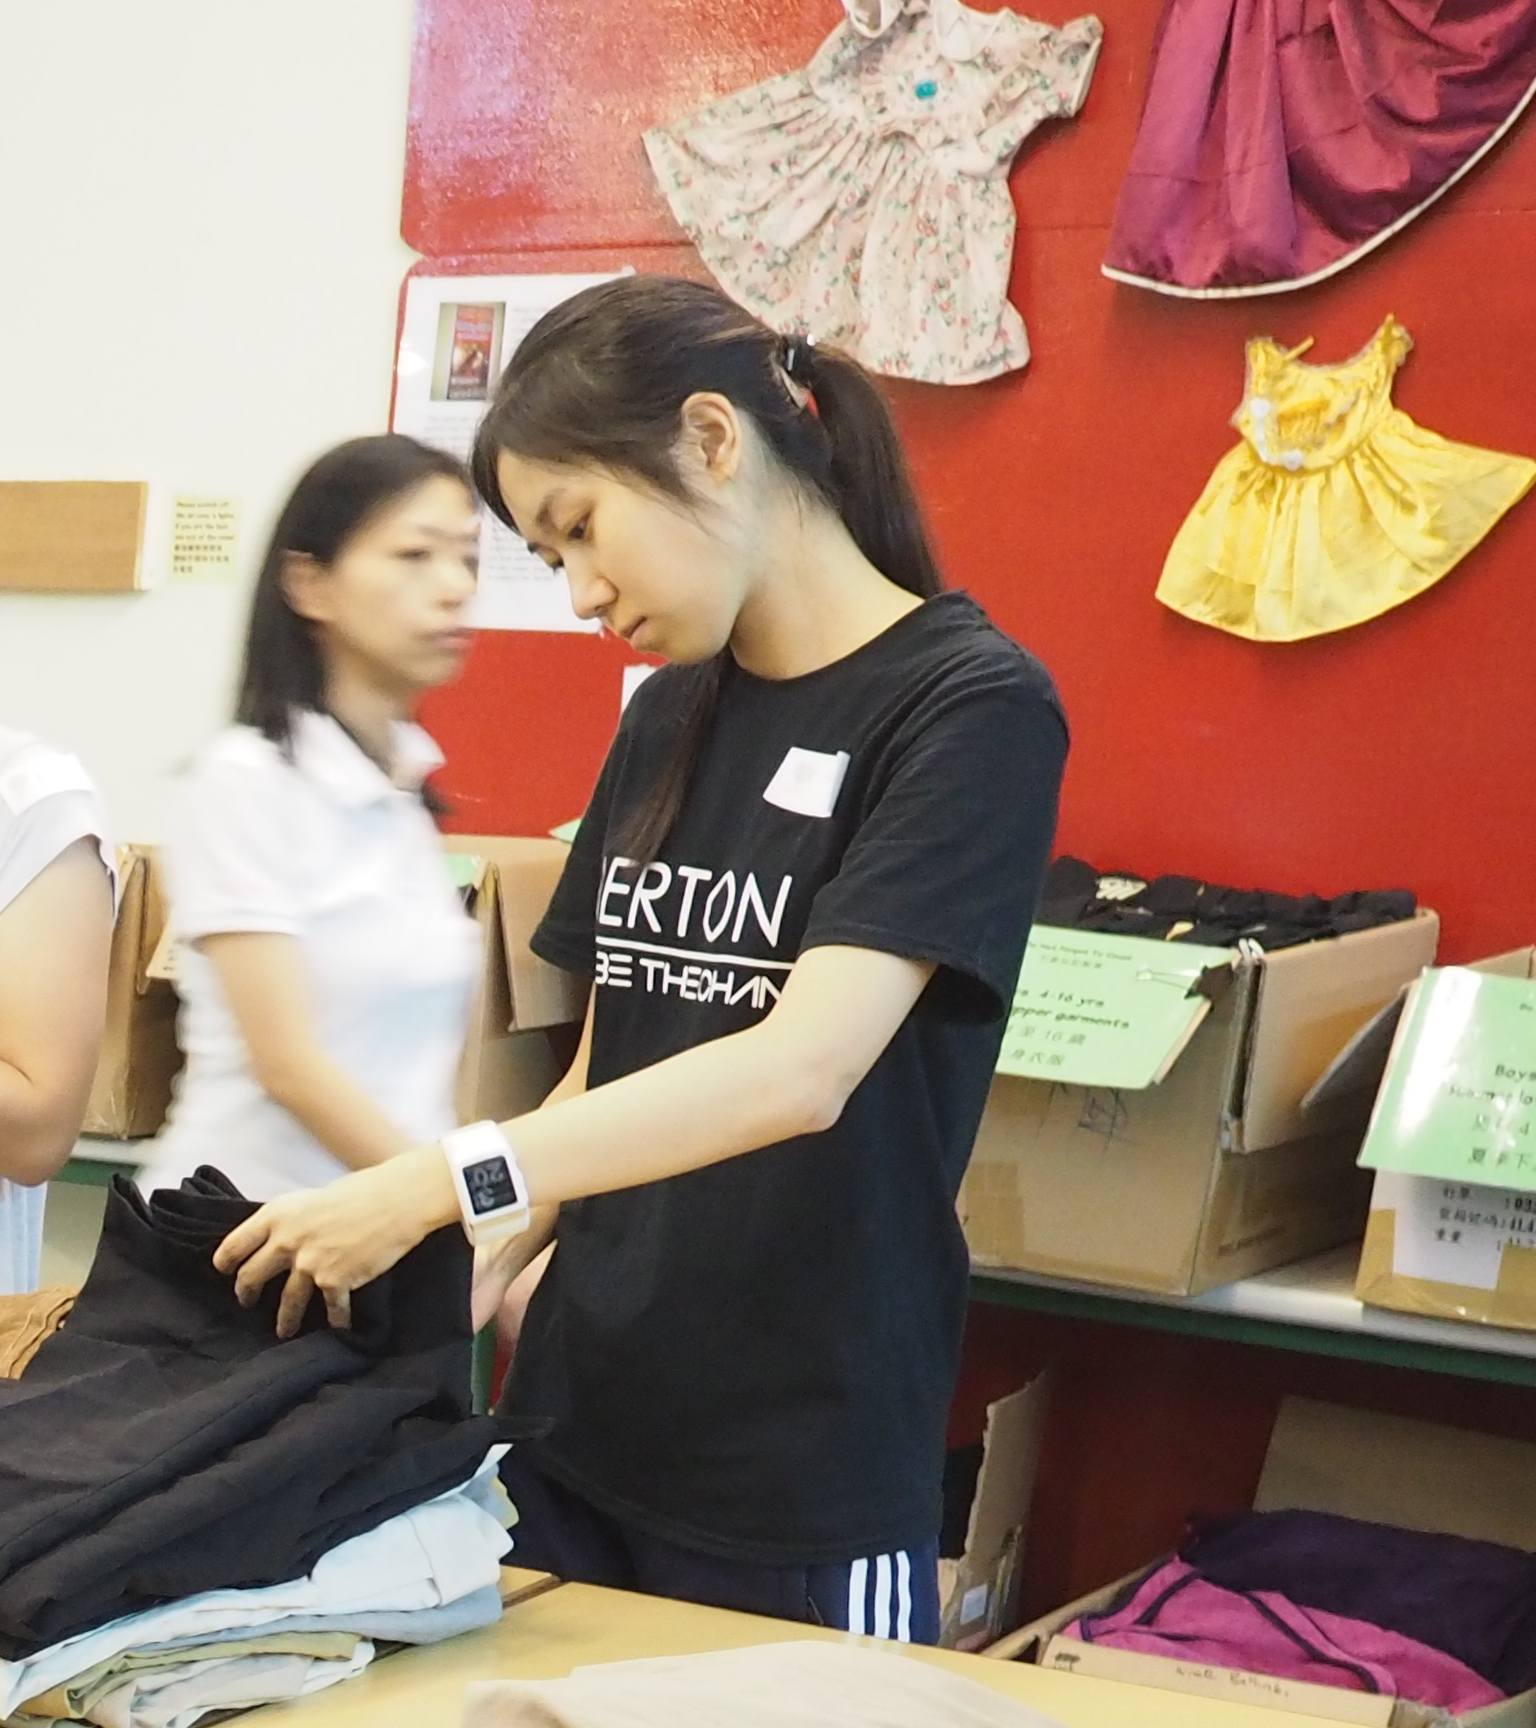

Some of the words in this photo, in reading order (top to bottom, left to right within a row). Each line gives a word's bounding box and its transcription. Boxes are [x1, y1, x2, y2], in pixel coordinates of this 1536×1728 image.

[595, 856, 793, 948] ERTON
[1012, 1006, 1052, 1019] pper
[1055, 1012, 1130, 1029] garments
